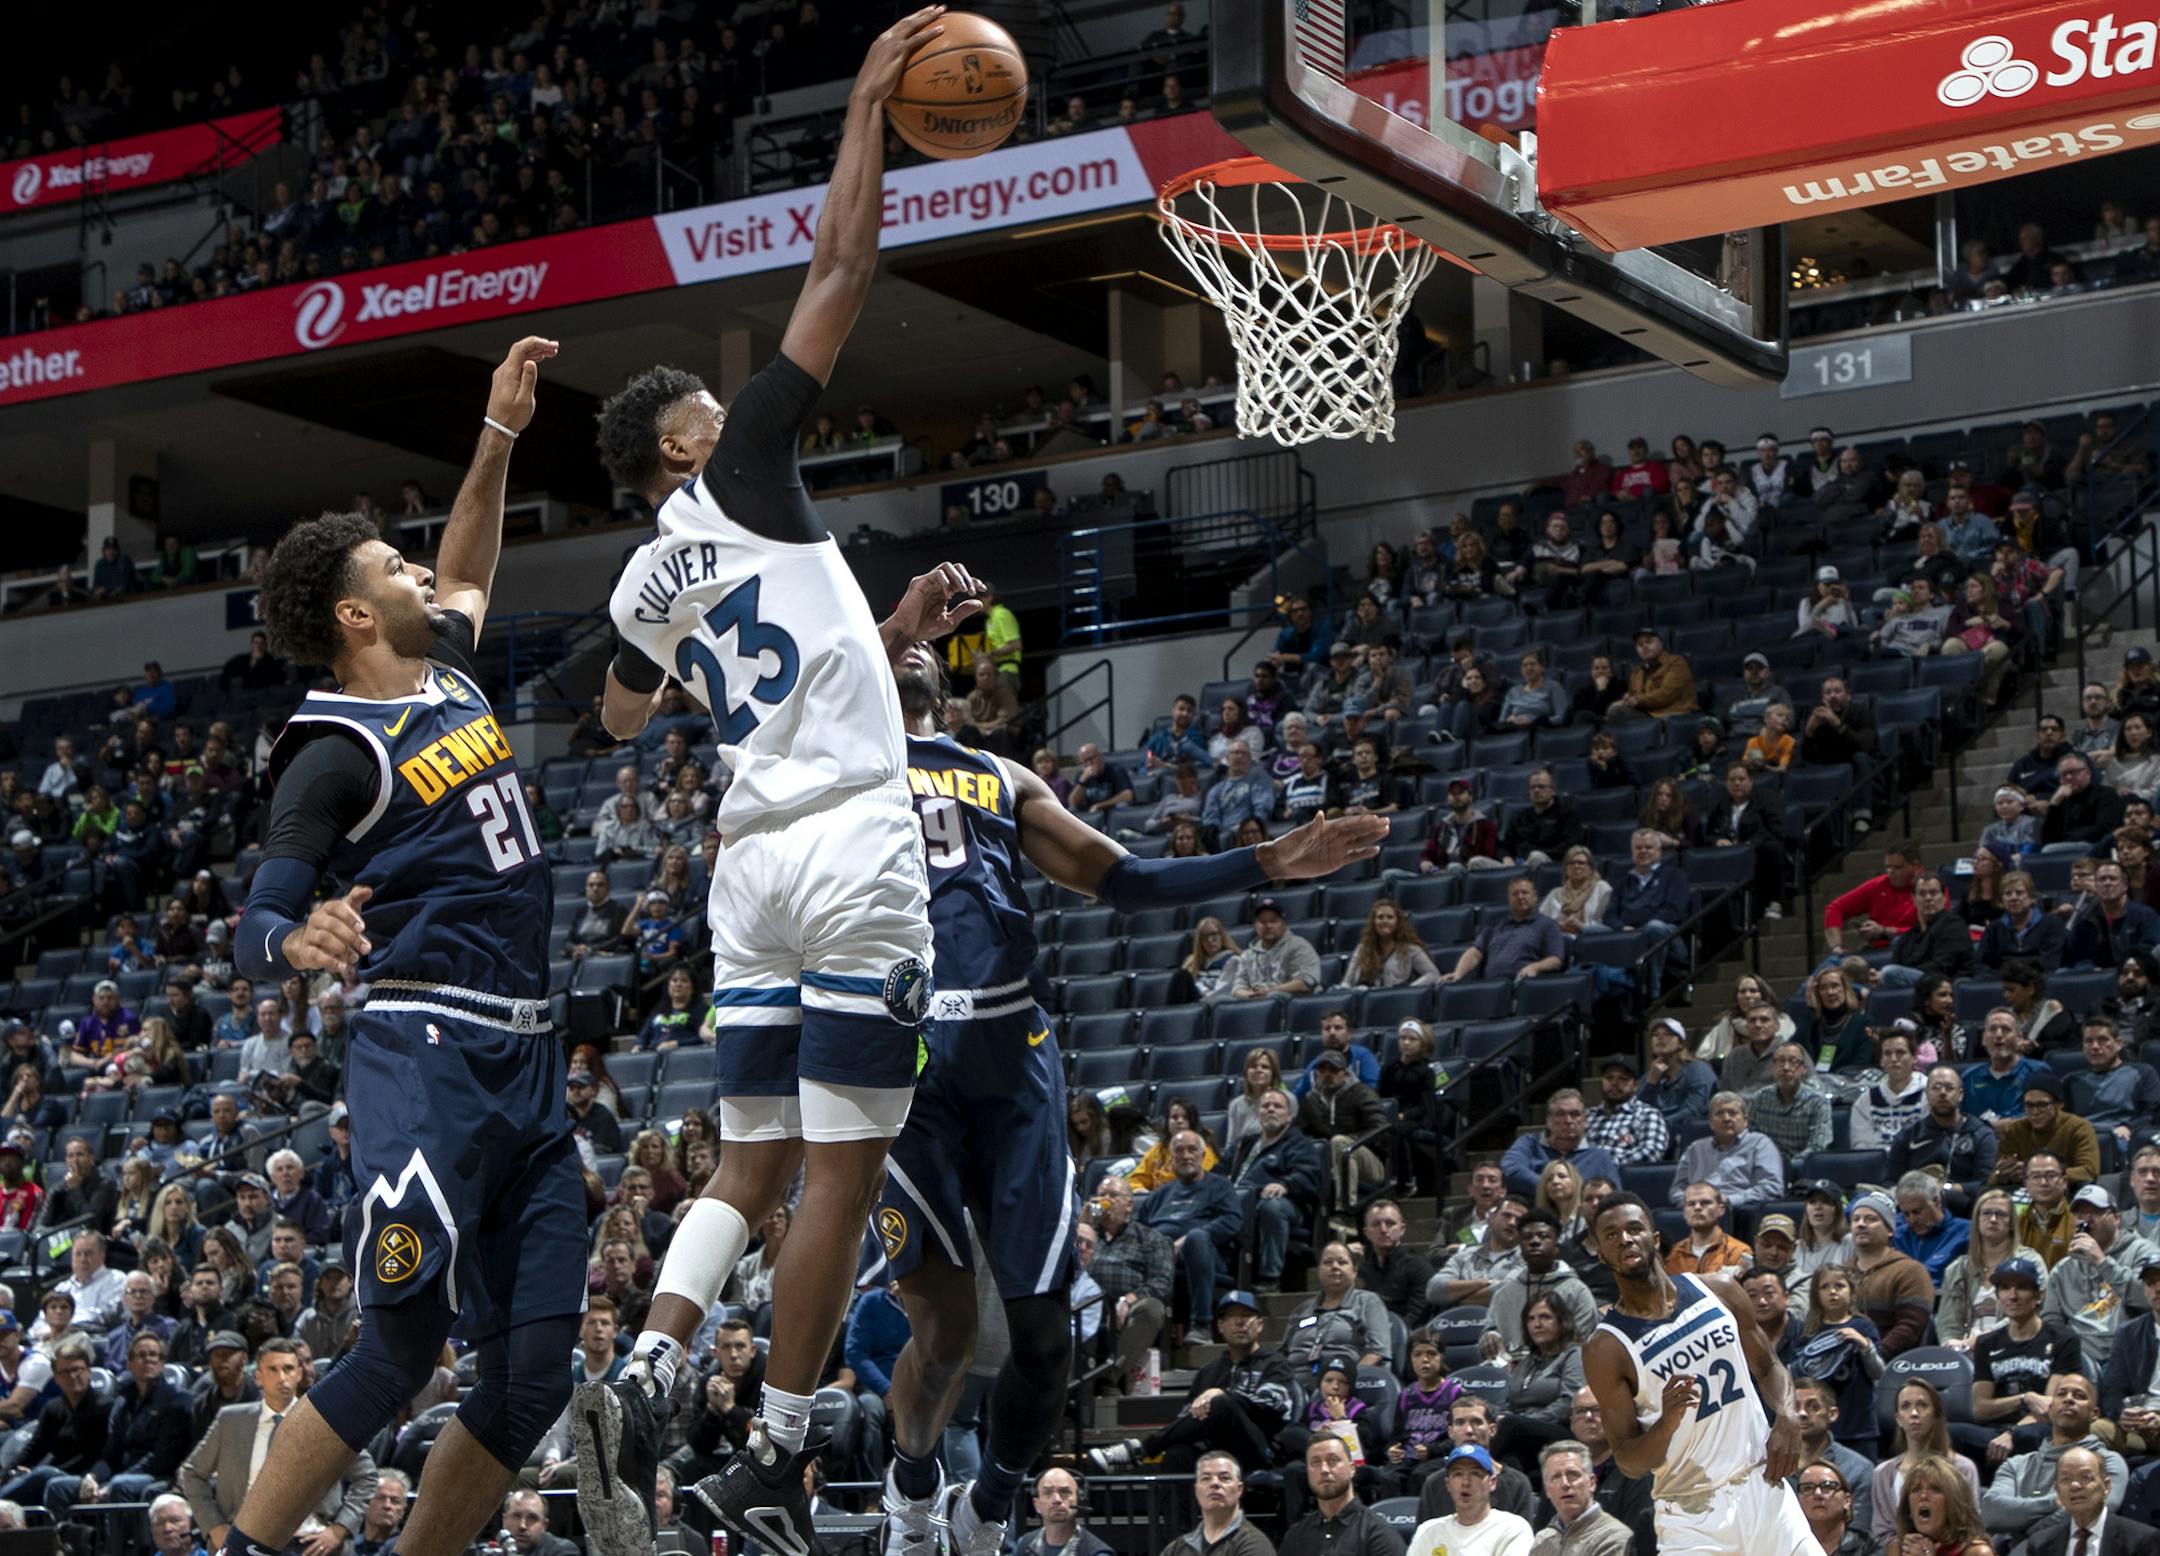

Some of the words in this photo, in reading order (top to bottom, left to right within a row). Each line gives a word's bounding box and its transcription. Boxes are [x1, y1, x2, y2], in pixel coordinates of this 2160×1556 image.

[2046, 13, 2160, 87] Sta
[685, 214, 773, 263] Visit
[787, 157, 1118, 246] XEnergy.com
[1814, 349, 1873, 386] 131
[969, 481, 1020, 515] 130
[634, 542, 717, 625] CULVER
[675, 573, 800, 745] 23
[398, 714, 513, 807] DENVE
[465, 771, 542, 873] 27
[920, 797, 967, 869] 9
[1463, 1380, 1507, 1388] LEXUS
[1651, 1325, 1735, 1381] WOLVES
[1911, 1361, 1960, 1371] LEXUS
[1692, 1358, 1746, 1423] 22
[1386, 1515, 1417, 1524] LEX
